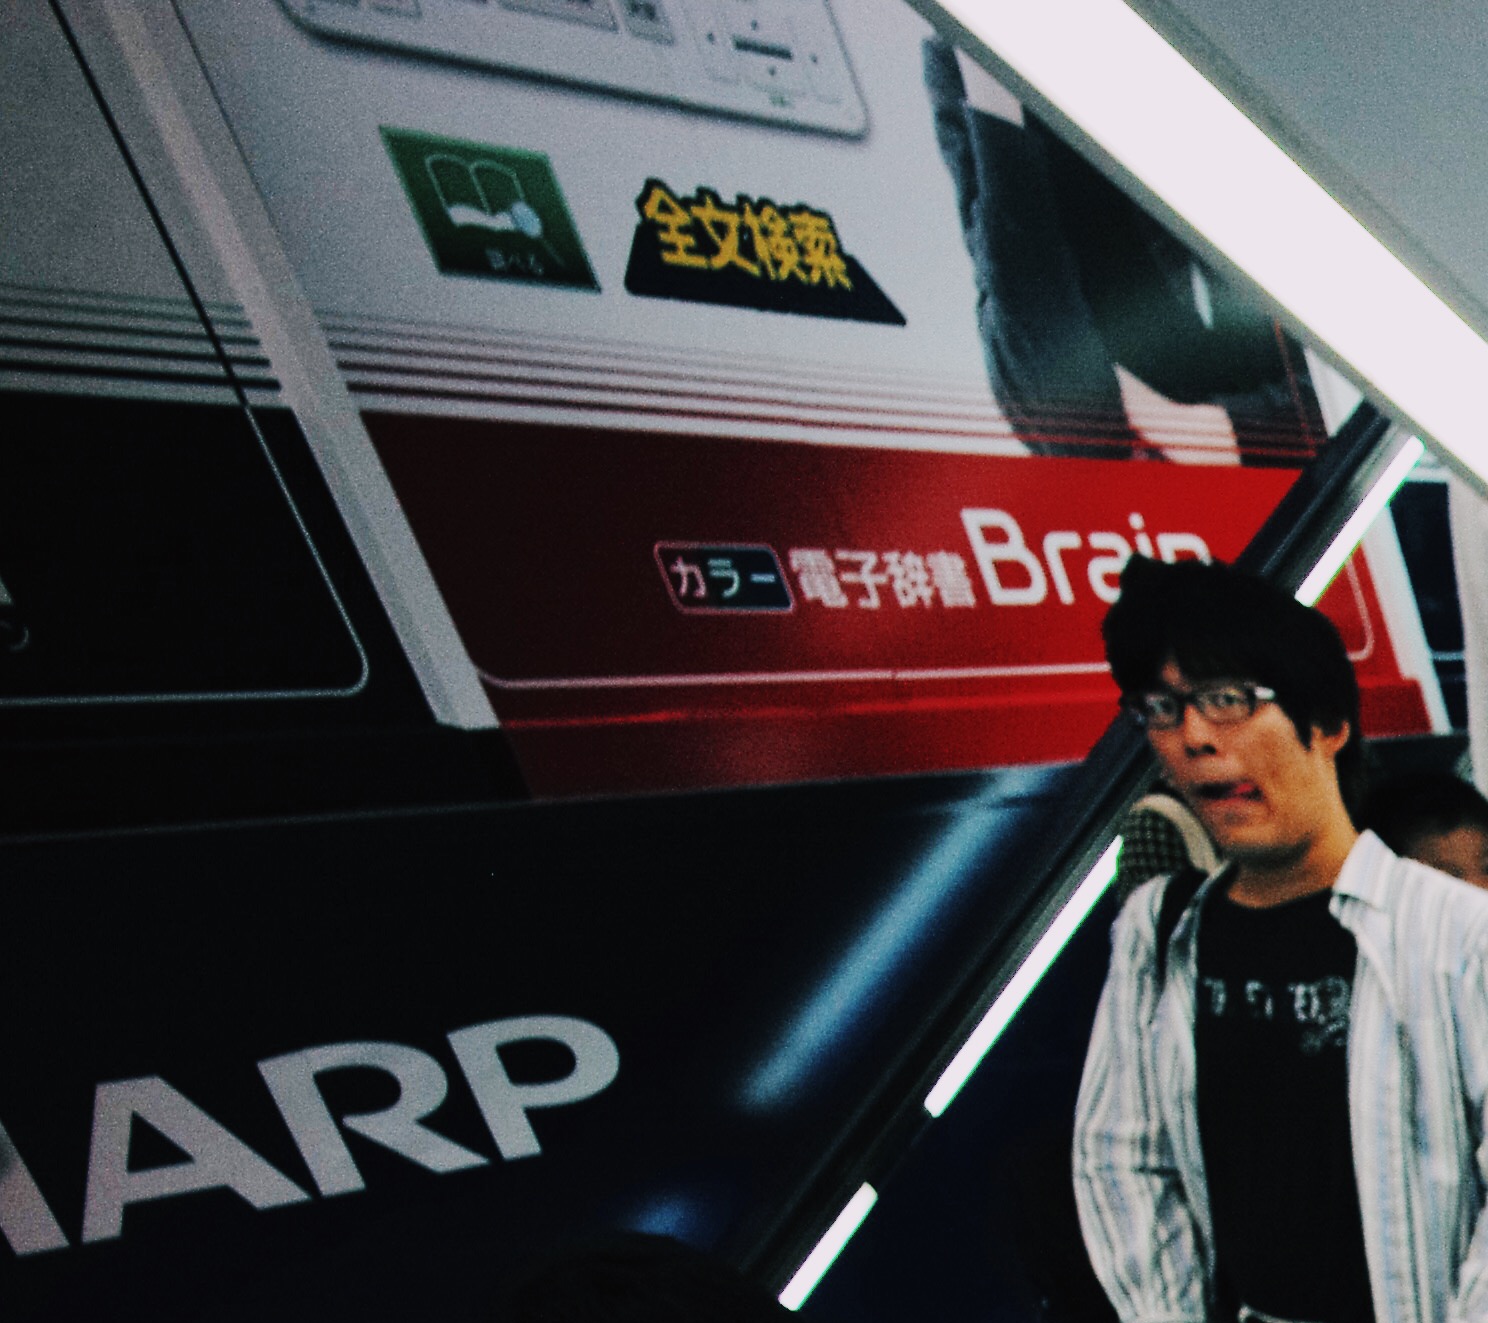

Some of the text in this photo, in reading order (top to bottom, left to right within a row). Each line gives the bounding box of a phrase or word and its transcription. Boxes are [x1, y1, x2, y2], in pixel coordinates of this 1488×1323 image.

[644, 184, 853, 292] 全文検索
[668, 555, 776, 598] カラー
[789, 548, 977, 609] 電子辞書
[0, 1013, 620, 1255] ARP
